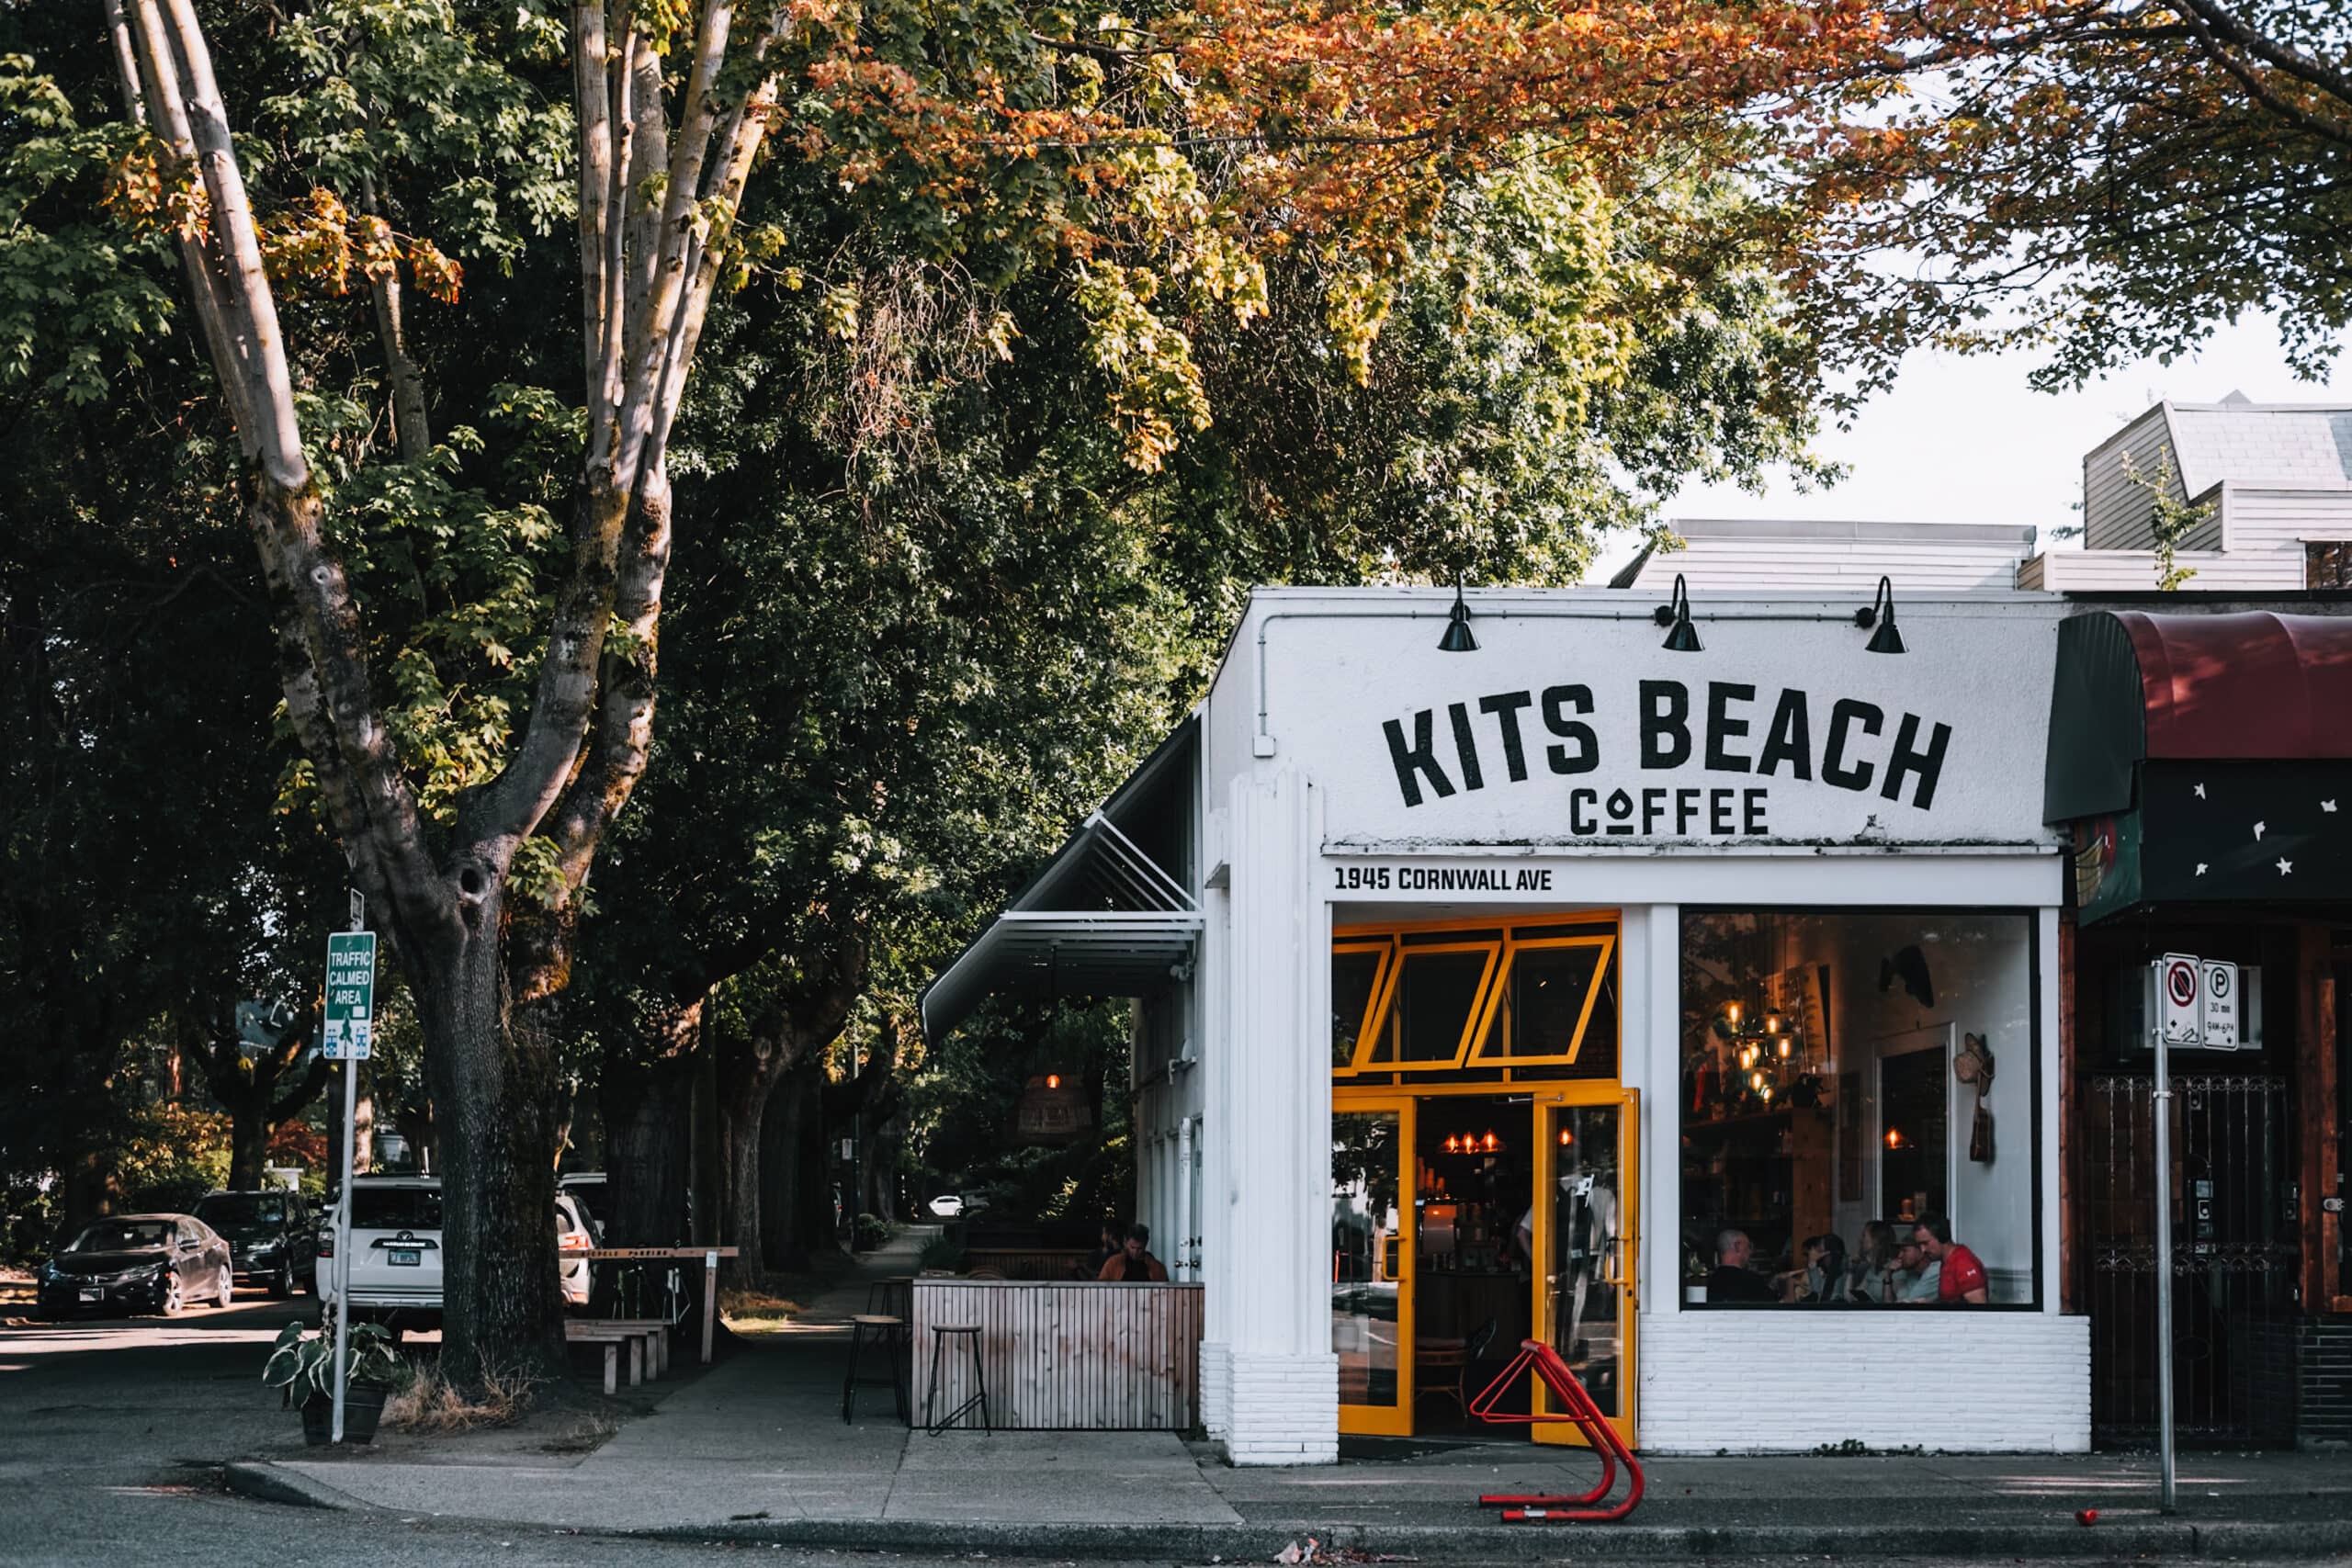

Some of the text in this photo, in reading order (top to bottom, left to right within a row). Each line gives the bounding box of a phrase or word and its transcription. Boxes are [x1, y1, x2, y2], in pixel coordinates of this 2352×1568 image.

[1382, 680, 1952, 811] KITS BEACH
[1570, 787, 1769, 835] COFFEE
[1335, 867, 1552, 891] 1945 CORNWALL AVE
[331, 951, 371, 966] TRAFFIC
[330, 971, 369, 986] CALMED
[2215, 973, 2225, 991] P
[334, 989, 362, 1005] AREA
[2211, 1001, 2219, 1012] 30
